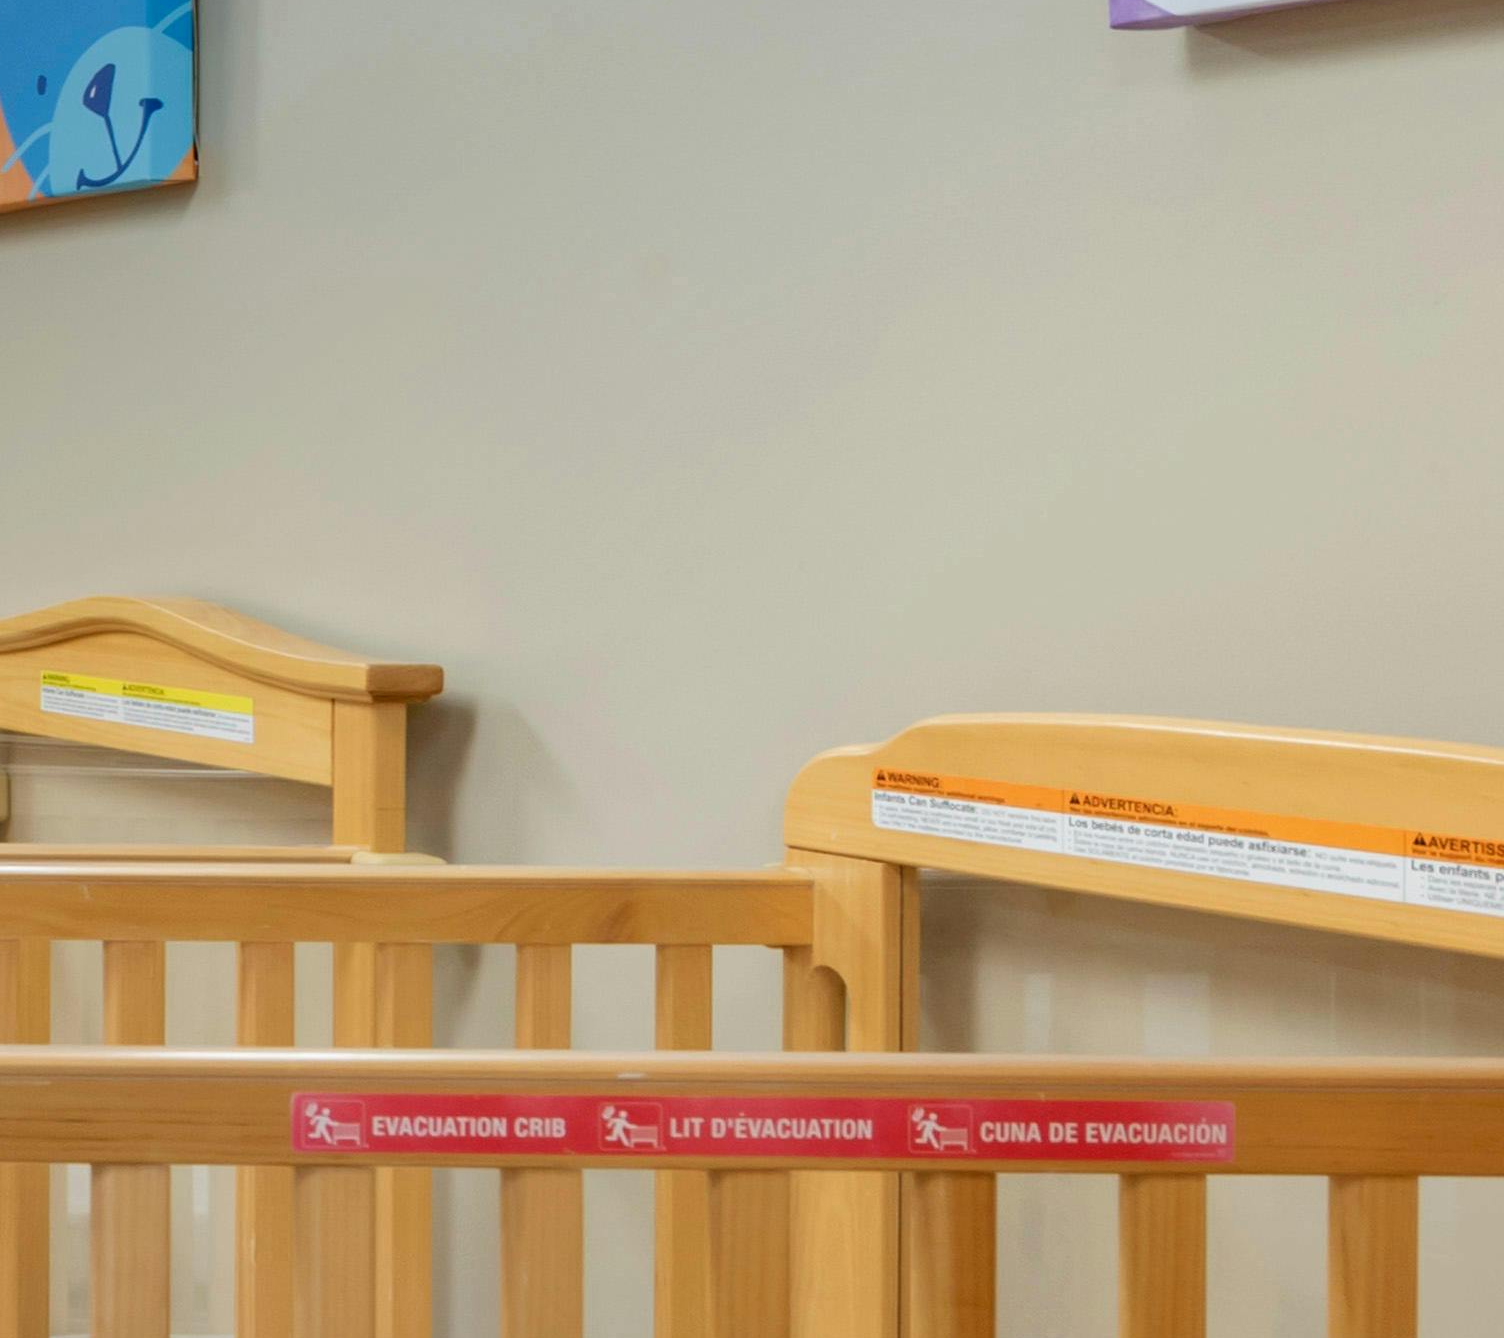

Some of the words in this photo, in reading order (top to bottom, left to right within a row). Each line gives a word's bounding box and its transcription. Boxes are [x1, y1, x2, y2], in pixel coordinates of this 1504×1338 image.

[909, 795, 926, 807] Can
[1068, 816, 1089, 830] Los
[1127, 825, 1142, 837] de
[1144, 827, 1173, 841] corta
[1176, 831, 1205, 844] edad
[1208, 835, 1245, 851] puede
[1411, 859, 1434, 873] Les
[1439, 864, 1490, 880] enfants
[371, 1115, 507, 1138] EVACUATION
[514, 1117, 567, 1139] CRIB
[669, 1116, 704, 1138] LIT
[711, 1111, 874, 1140] D'ÉVACUATION
[979, 1120, 1042, 1143] CUNA
[1049, 1121, 1079, 1144] DE
[1085, 1117, 1228, 1145] EVACUACIÓN
